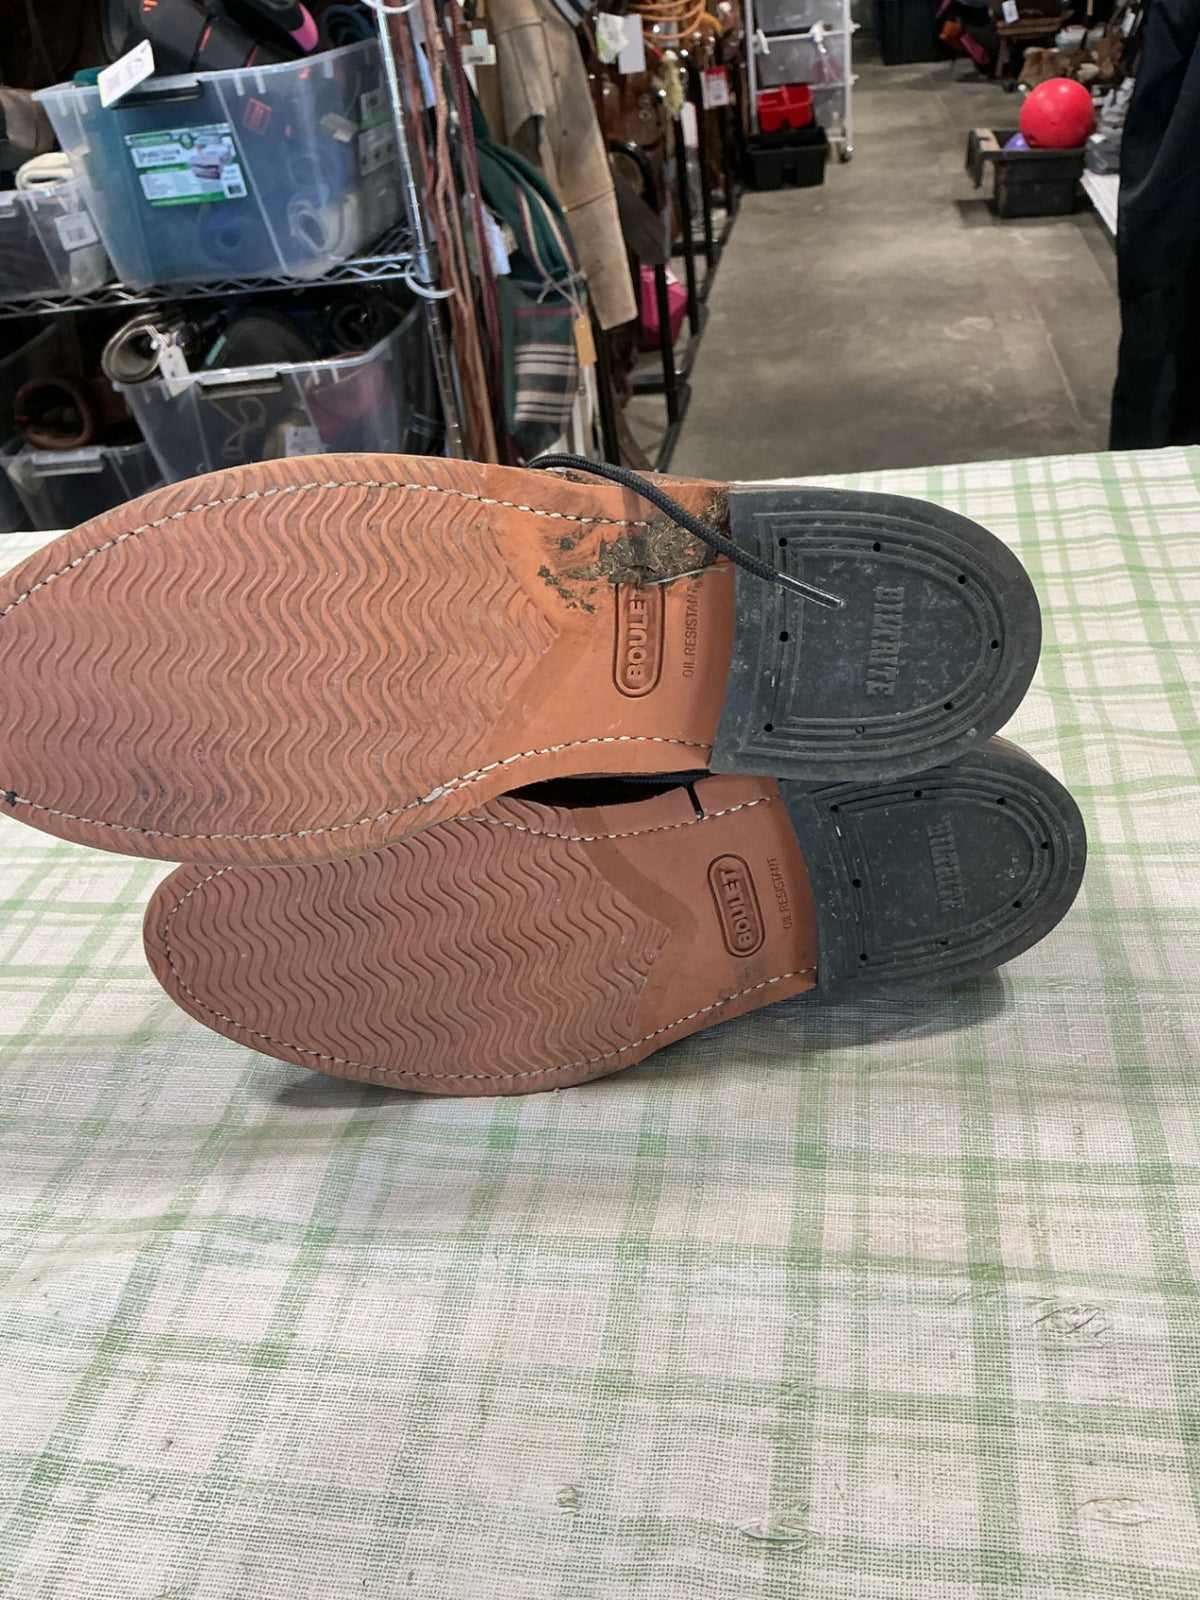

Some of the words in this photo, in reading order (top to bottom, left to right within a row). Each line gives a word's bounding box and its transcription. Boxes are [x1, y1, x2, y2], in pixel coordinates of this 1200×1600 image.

[684, 586, 699, 656] RESISTANT
[866, 585, 905, 696] BILTRITE
[682, 660, 695, 678] OIL
[720, 868, 754, 948] BOULET
[767, 858, 790, 912] RESISTANT
[781, 912, 793, 930] OIL
